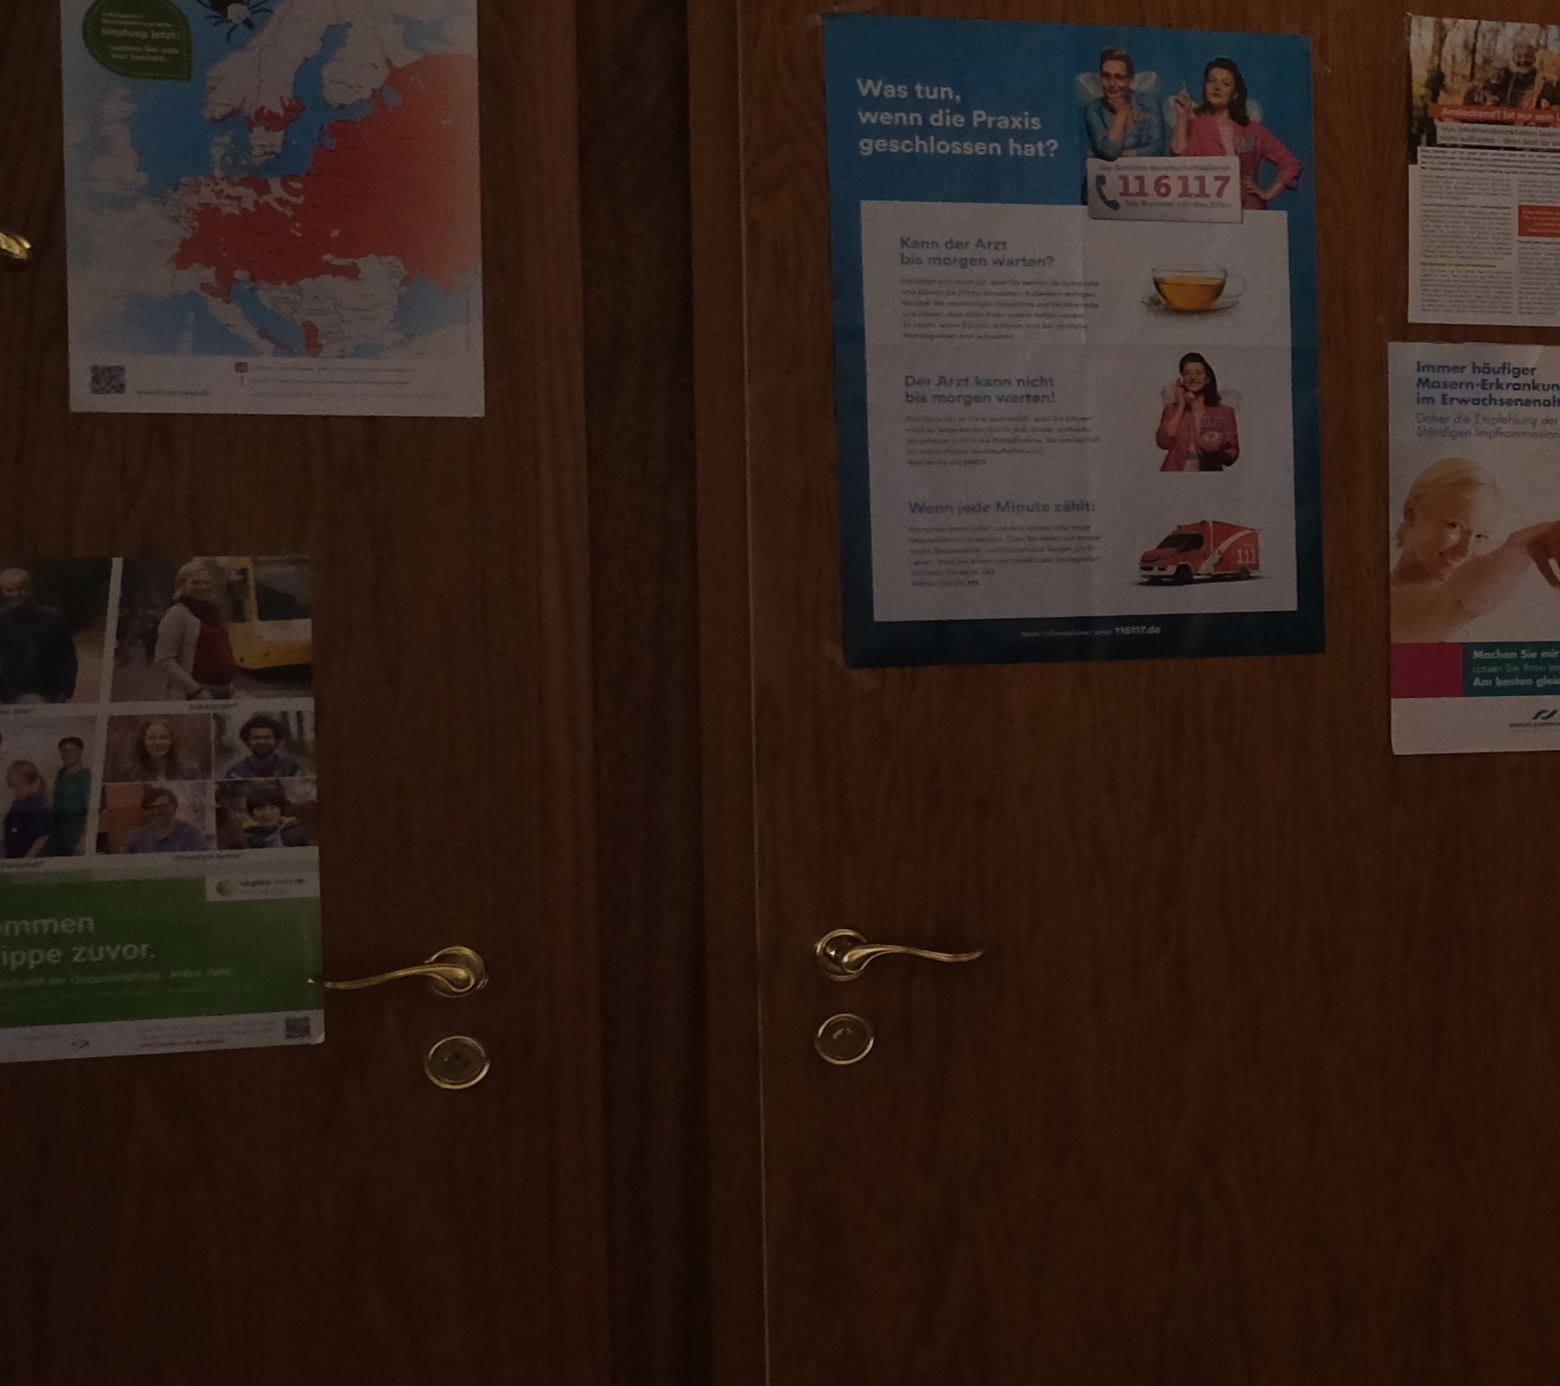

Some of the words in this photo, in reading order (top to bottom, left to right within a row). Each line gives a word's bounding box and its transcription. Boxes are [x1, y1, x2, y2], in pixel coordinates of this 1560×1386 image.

[857, 78, 908, 99] Was
[915, 82, 961, 103] tun,
[858, 111, 923, 126] wenn
[929, 109, 965, 127] die
[972, 110, 1042, 131] Praxis
[859, 135, 1001, 156] geschlossen
[1009, 138, 1058, 157] hat?
[900, 237, 939, 250] Kann
[944, 238, 970, 251] der
[975, 238, 1008, 251] Arzt
[900, 253, 924, 266] bis
[927, 255, 988, 270] morgen
[992, 255, 1055, 268] warten?
[1416, 361, 1467, 374] Immer
[1471, 363, 1538, 379] häufiger
[905, 375, 931, 388] Der
[936, 375, 970, 388] Arzt
[974, 376, 1011, 388] kann
[1017, 376, 1055, 388] nicht
[905, 393, 927, 405] bis
[931, 394, 990, 408] morgen
[1416, 393, 1435, 405] im
[909, 502, 953, 515] Wenn
[957, 502, 991, 516] jede
[995, 500, 1051, 514] Minute
[1473, 649, 1517, 660] Machen
[1521, 648, 1538, 660] Sie
[1473, 676, 1492, 688] Am
[1495, 675, 1533, 687] besten
[0, 946, 63, 971] ippe
[72, 943, 156, 963] zuvor.
